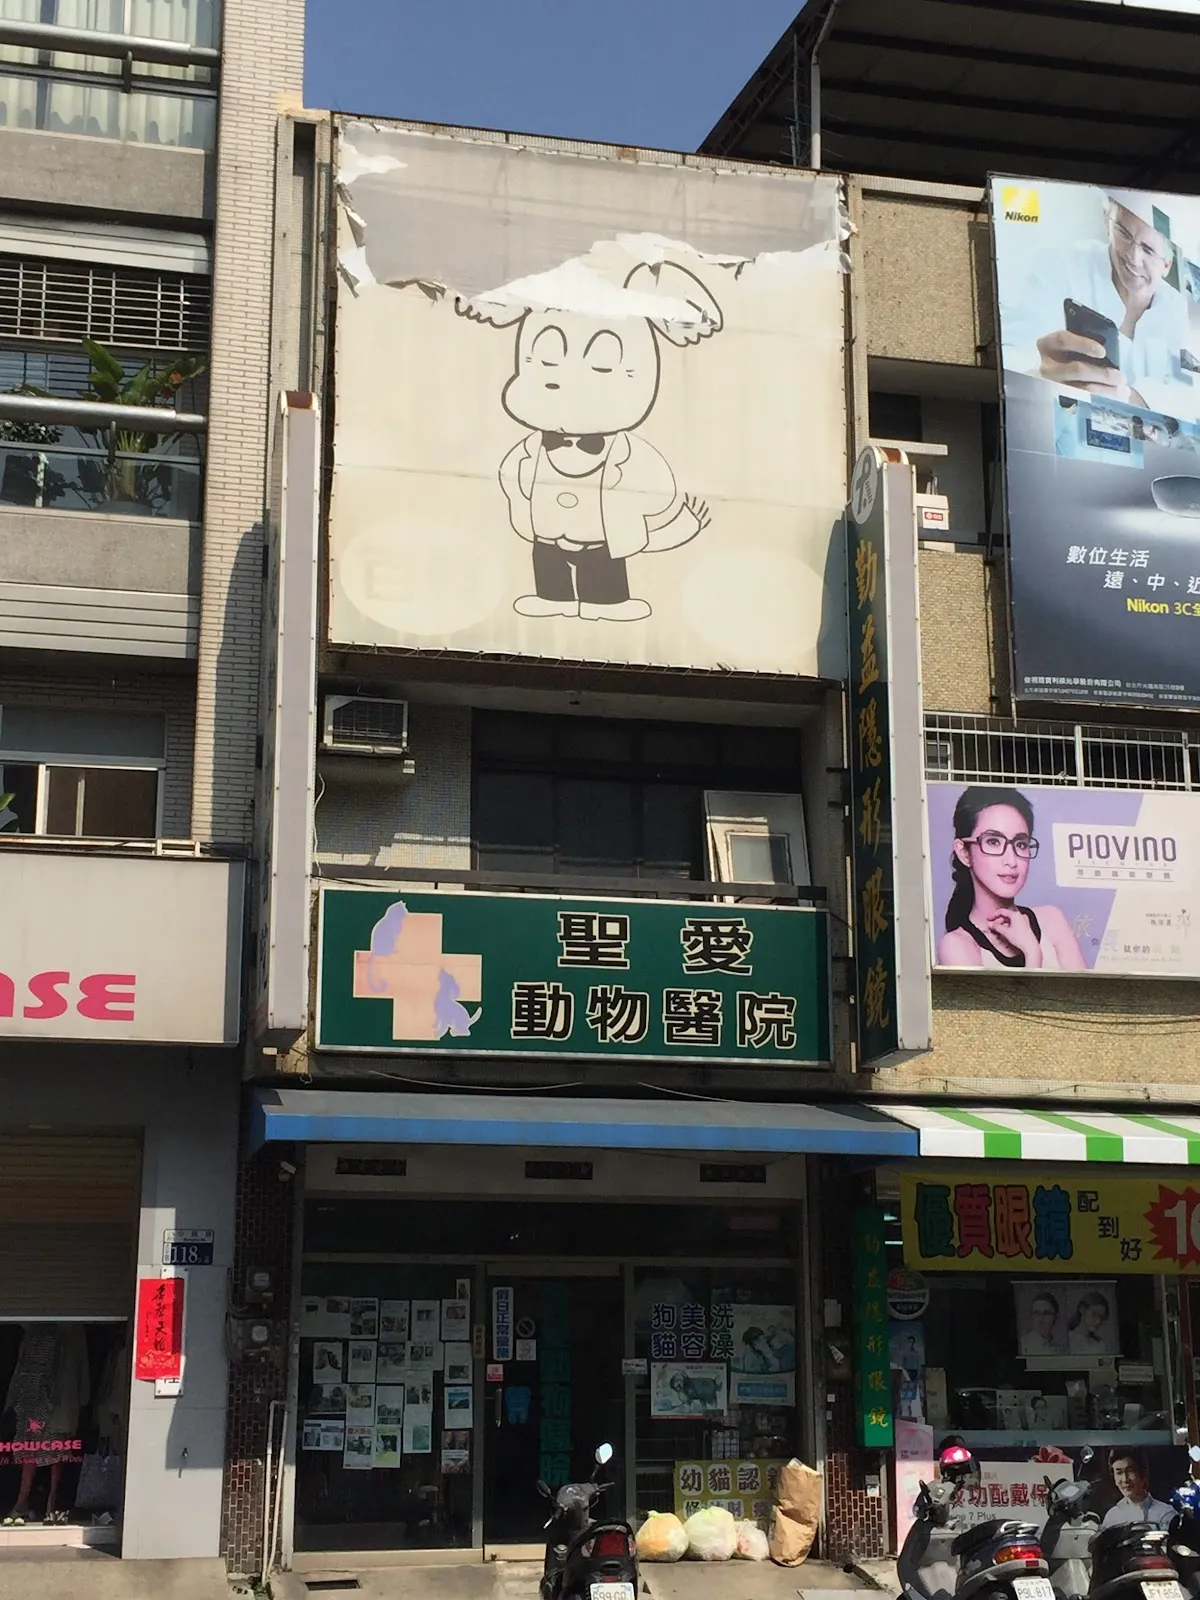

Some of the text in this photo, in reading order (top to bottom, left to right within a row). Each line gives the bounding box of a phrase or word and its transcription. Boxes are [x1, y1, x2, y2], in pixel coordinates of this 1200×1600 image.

[1005, 211, 1039, 223] Nikon
[1066, 545, 1151, 569] 數位生活
[1126, 598, 1170, 615] Nikon
[854, 538, 890, 1031] 勤益隱形眼鏡
[1068, 833, 1177, 861] PIOVINO
[556, 910, 754, 976] 聖愛
[511, 981, 798, 1050] 動物醫院
[915, 1182, 1073, 1260] 優質眼鏡
[1077, 1190, 1143, 1261] 配到好
[171, 1245, 198, 1263] 118
